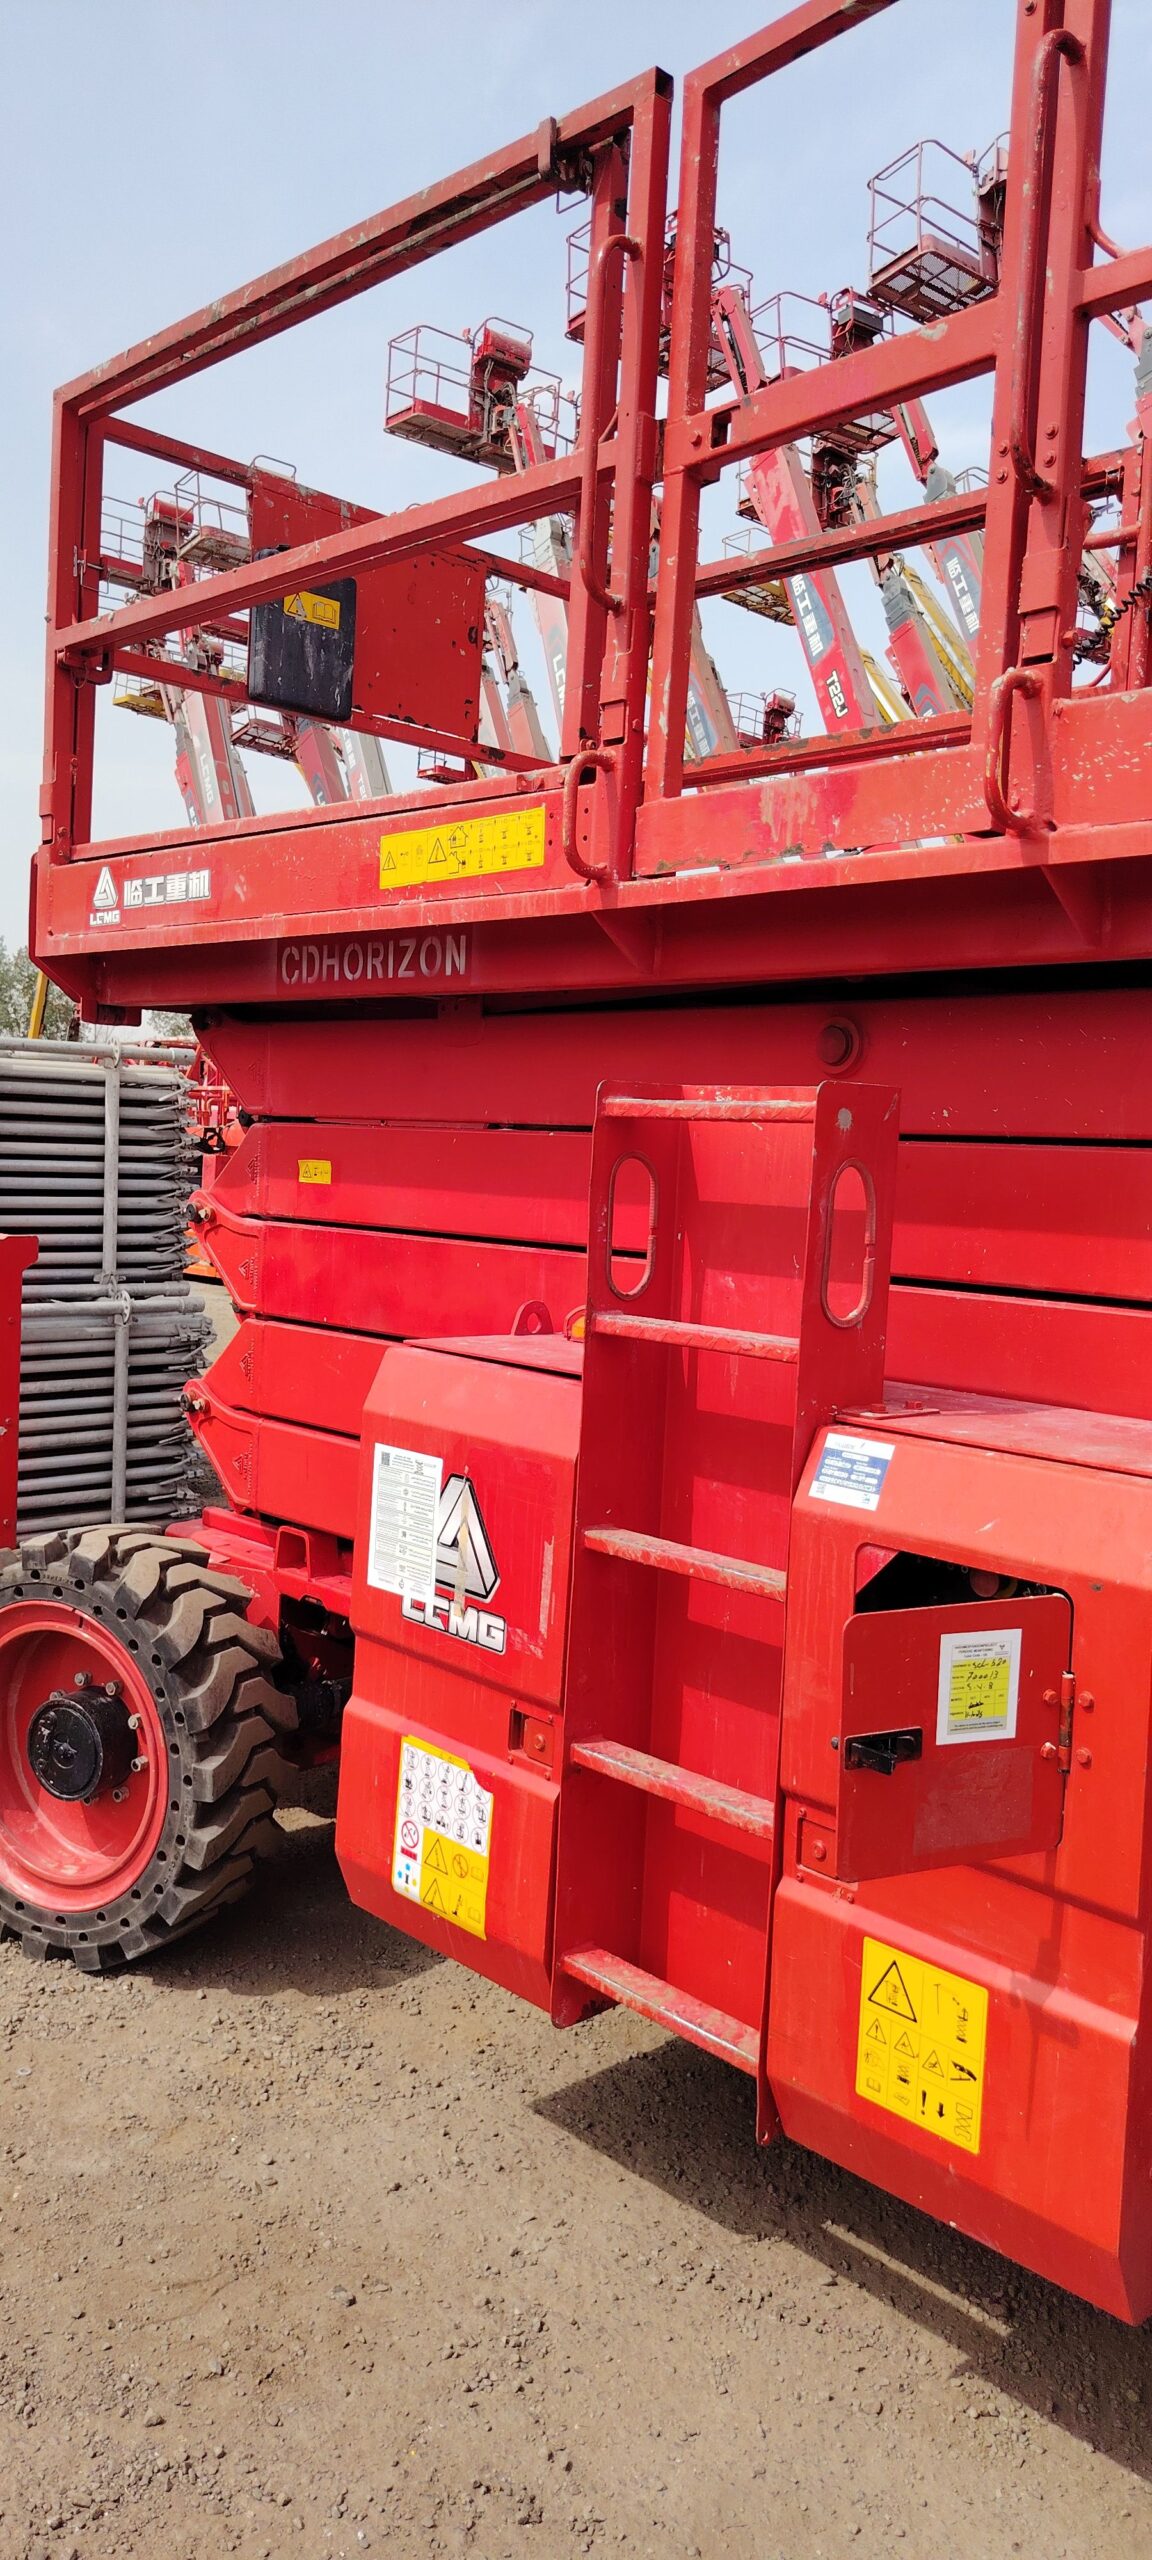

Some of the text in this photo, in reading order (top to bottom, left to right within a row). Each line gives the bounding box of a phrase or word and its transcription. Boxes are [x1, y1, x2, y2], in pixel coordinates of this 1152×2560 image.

[826, 670, 848, 718] T22J
[123, 869, 210, 908] 临工重机
[89, 910, 120, 926] LCMG
[281, 935, 466, 984] CDHORIZON
